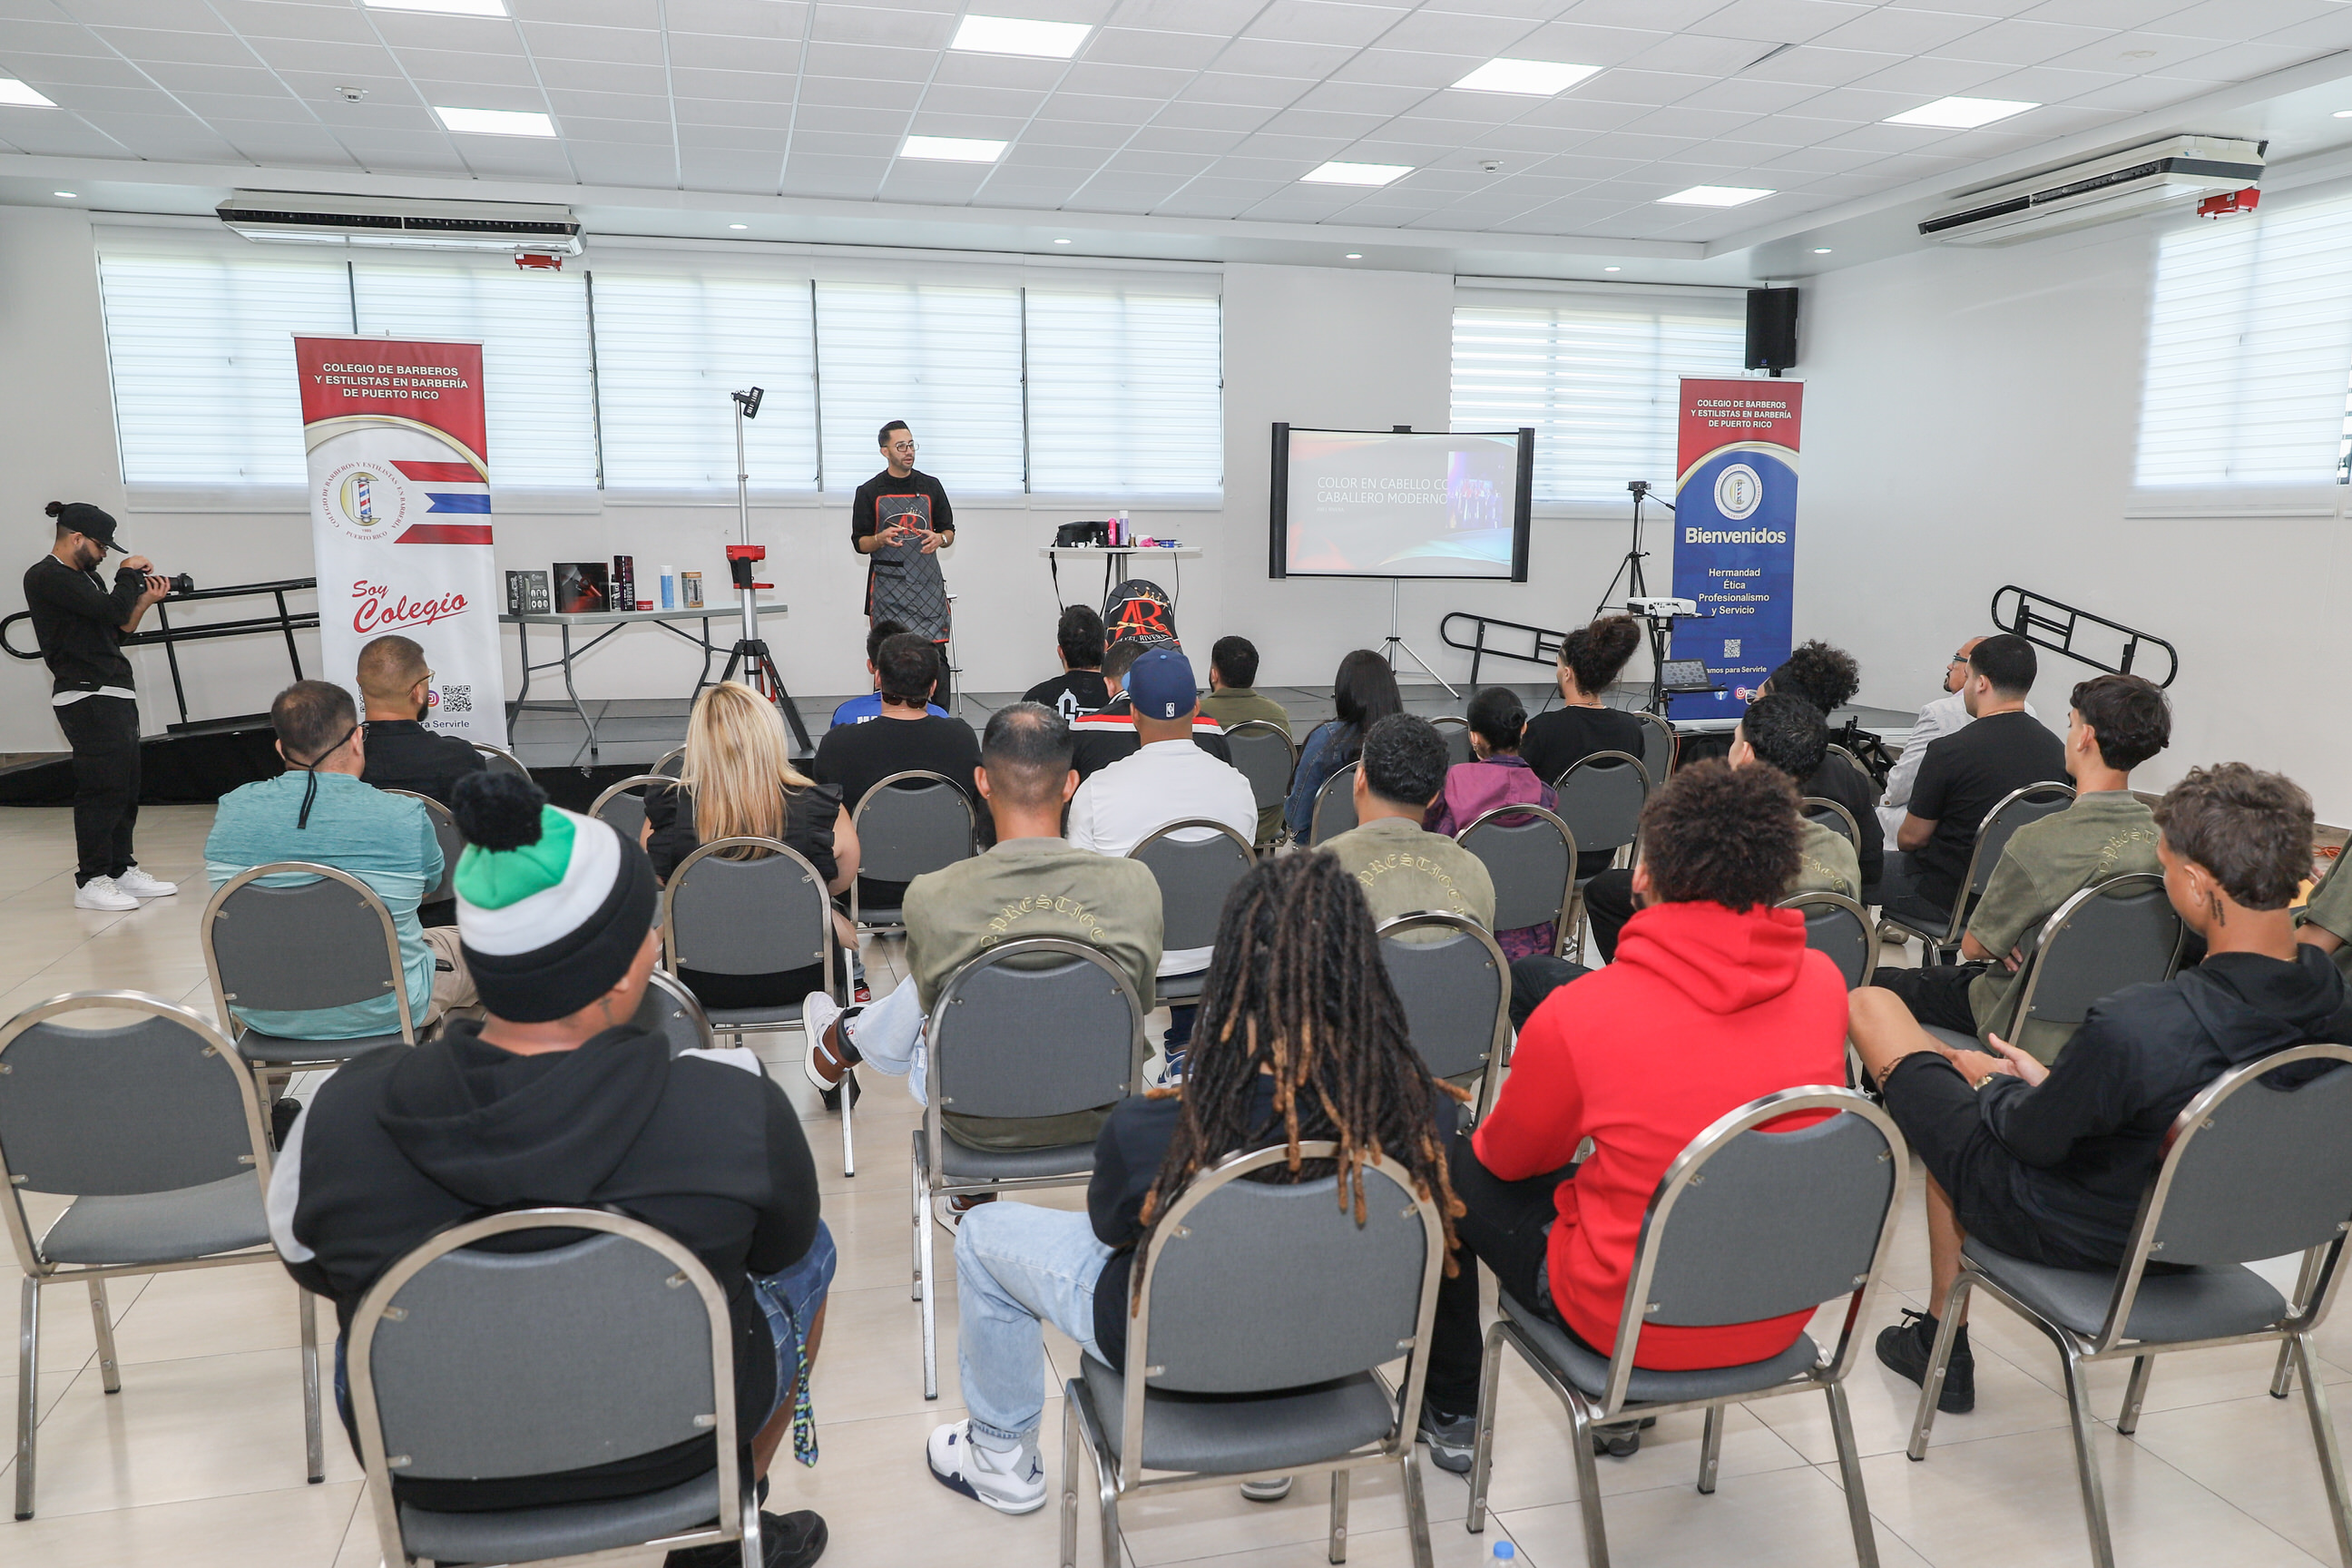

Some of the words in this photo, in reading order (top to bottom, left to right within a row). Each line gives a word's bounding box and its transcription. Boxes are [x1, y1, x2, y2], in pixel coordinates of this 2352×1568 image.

[323, 363, 375, 374] COLEGIO
[377, 365, 394, 374] DE
[397, 366, 458, 377] BARBEROS
[315, 375, 322, 384] Y
[326, 376, 390, 387] ESTILISTAS
[393, 377, 408, 387] EN
[411, 376, 468, 389] BARBERÍA
[343, 388, 359, 397] DE
[362, 389, 408, 399] PUERTO
[411, 390, 439, 400] RICO
[1697, 399, 1731, 407] COLEGIO
[1746, 400, 1787, 409] BARBEROS
[1698, 409, 1741, 417] ESTILISTAS
[1742, 410, 1753, 418] EN
[1754, 409, 1792, 419] BARBERÍA
[1709, 419, 1720, 427] DE
[1720, 420, 1751, 428] PUERTO
[1753, 420, 1772, 428] RICO
[1318, 476, 1357, 488] COLOR
[1361, 477, 1377, 489] EN
[1379, 477, 1430, 490] CABELLO
[1318, 491, 1384, 504] CABALLERO
[1387, 492, 1448, 505] MODERNO
[346, 531, 372, 541] PUERTO
[373, 531, 387, 540] RICO
[1685, 527, 1787, 544] Bienvenidos
[1709, 568, 1760, 577] Hermandad
[352, 580, 388, 598] Soy
[1723, 579, 1746, 590] Ética
[1699, 593, 1769, 603] Profesionalismo
[353, 593, 468, 633] Colegio
[1710, 607, 1718, 617] y
[1719, 605, 1755, 614] Servicio
[1725, 667, 1740, 675] para
[1741, 665, 1767, 673] Servirle
[1357, 853, 1462, 900] PRESTIGE
